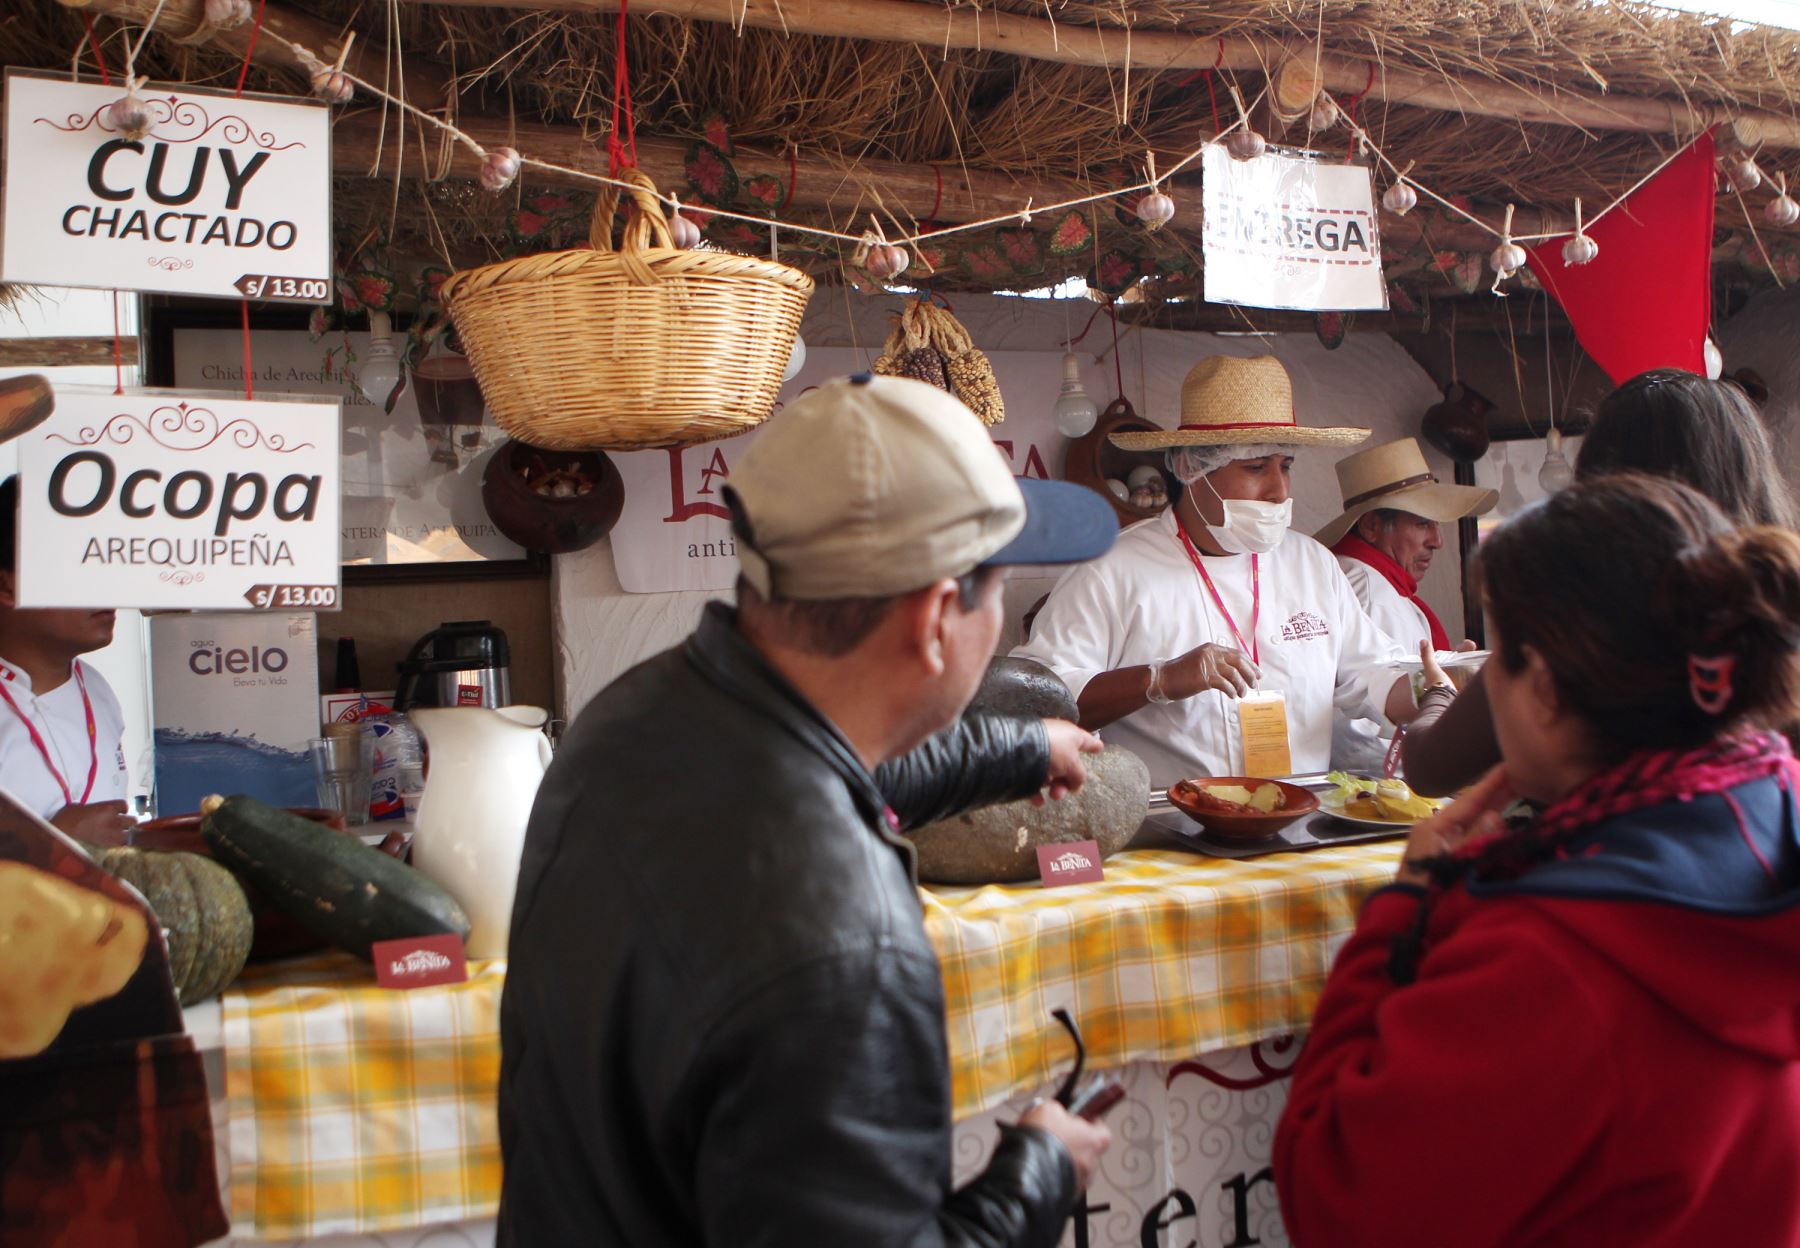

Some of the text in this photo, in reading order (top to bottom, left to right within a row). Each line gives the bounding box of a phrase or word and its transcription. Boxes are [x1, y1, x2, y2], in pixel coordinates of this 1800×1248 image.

[87, 138, 271, 210] CUY
[62, 205, 298, 251] CHACTADO
[1217, 202, 1368, 253] ENREGA
[272, 279, 327, 299] 13.00
[263, 366, 282, 381] de
[48, 450, 322, 537] Ocopa
[82, 534, 295, 567] AREQUIPEÑA
[281, 587, 335, 606] 13.00
[190, 640, 215, 649] agua
[189, 646, 289, 675] cielo
